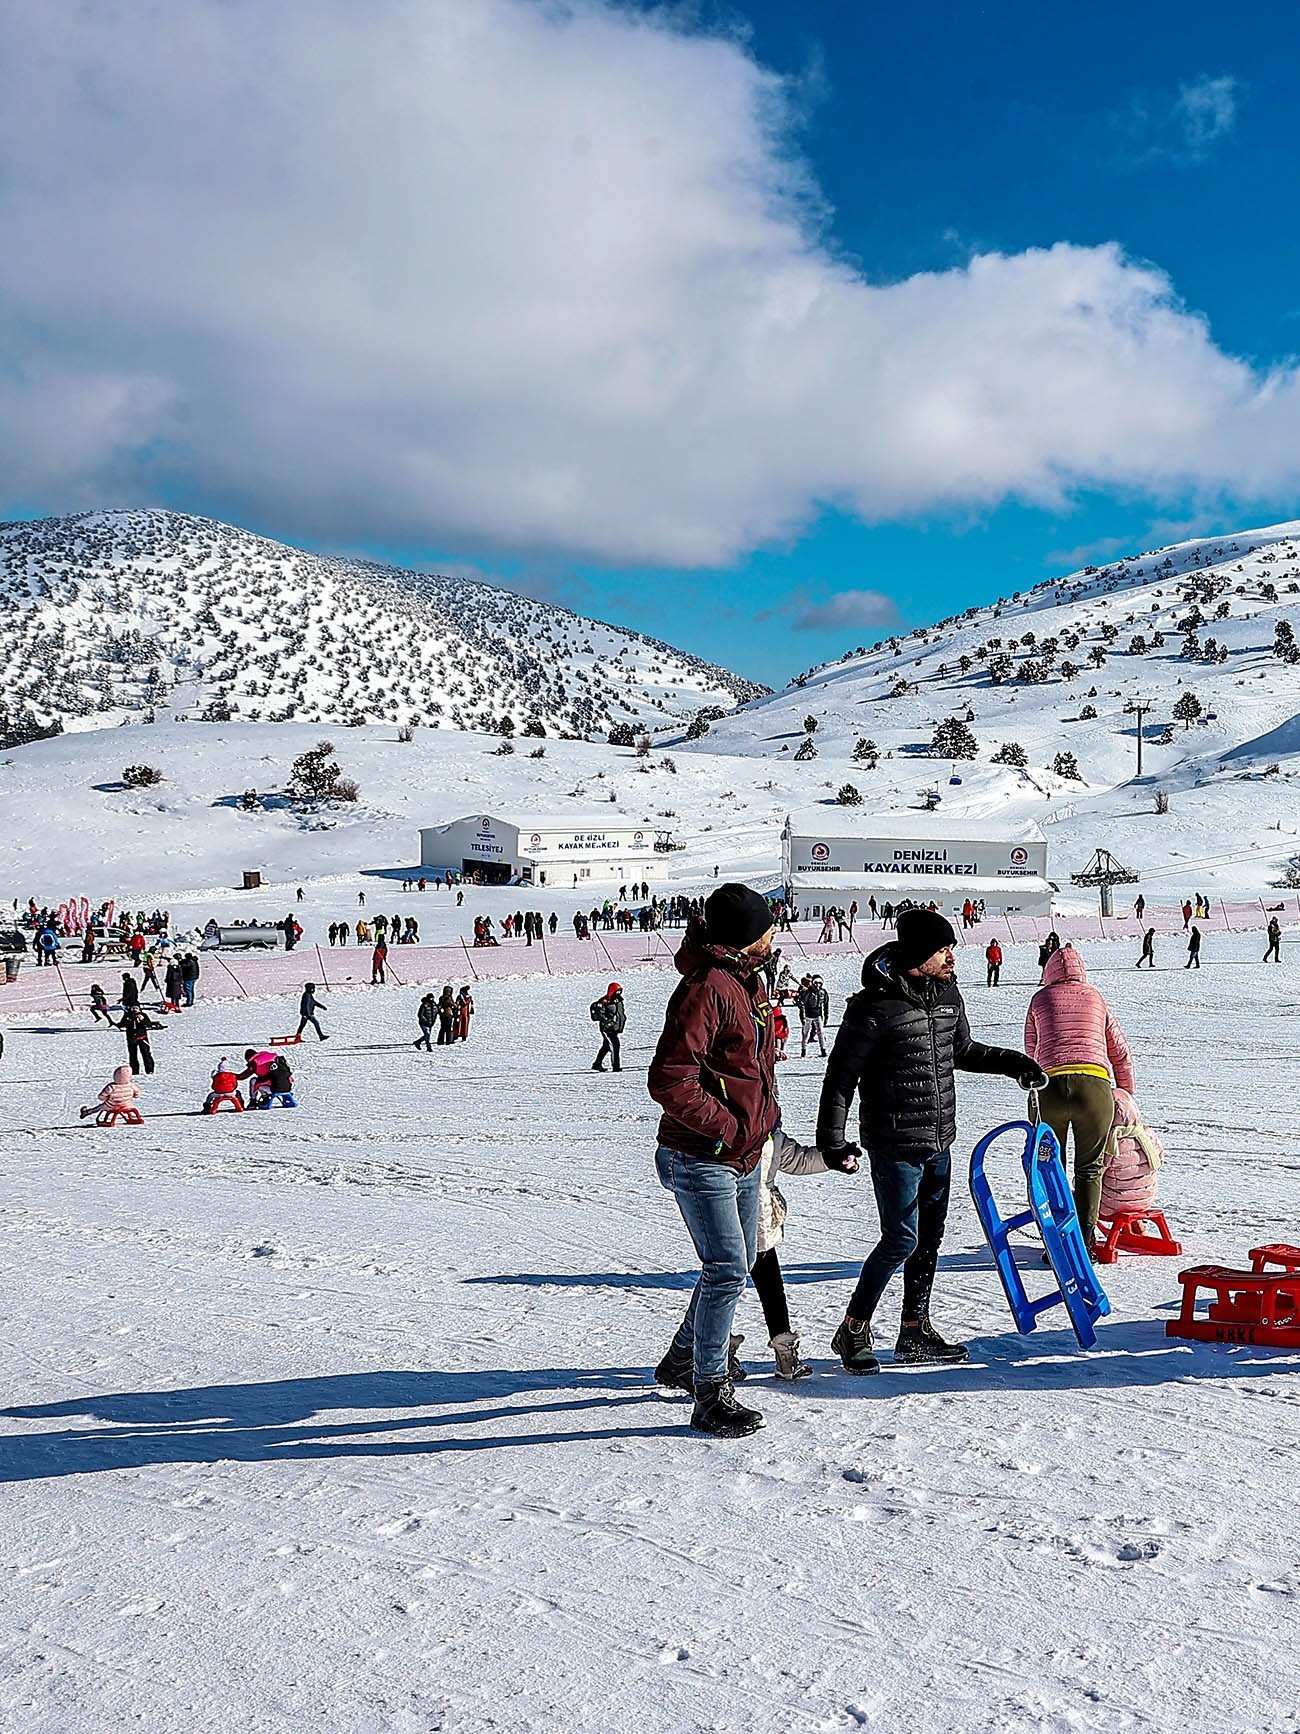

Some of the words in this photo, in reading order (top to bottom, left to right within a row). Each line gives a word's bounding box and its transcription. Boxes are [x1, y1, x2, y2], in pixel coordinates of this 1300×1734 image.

[470, 843, 504, 854] TELESİYEJ
[558, 842, 584, 850] KAYAK
[893, 848, 947, 861] DENİZLİ
[864, 862, 911, 873] KAYAK
[913, 862, 978, 875] MERKEZİ
